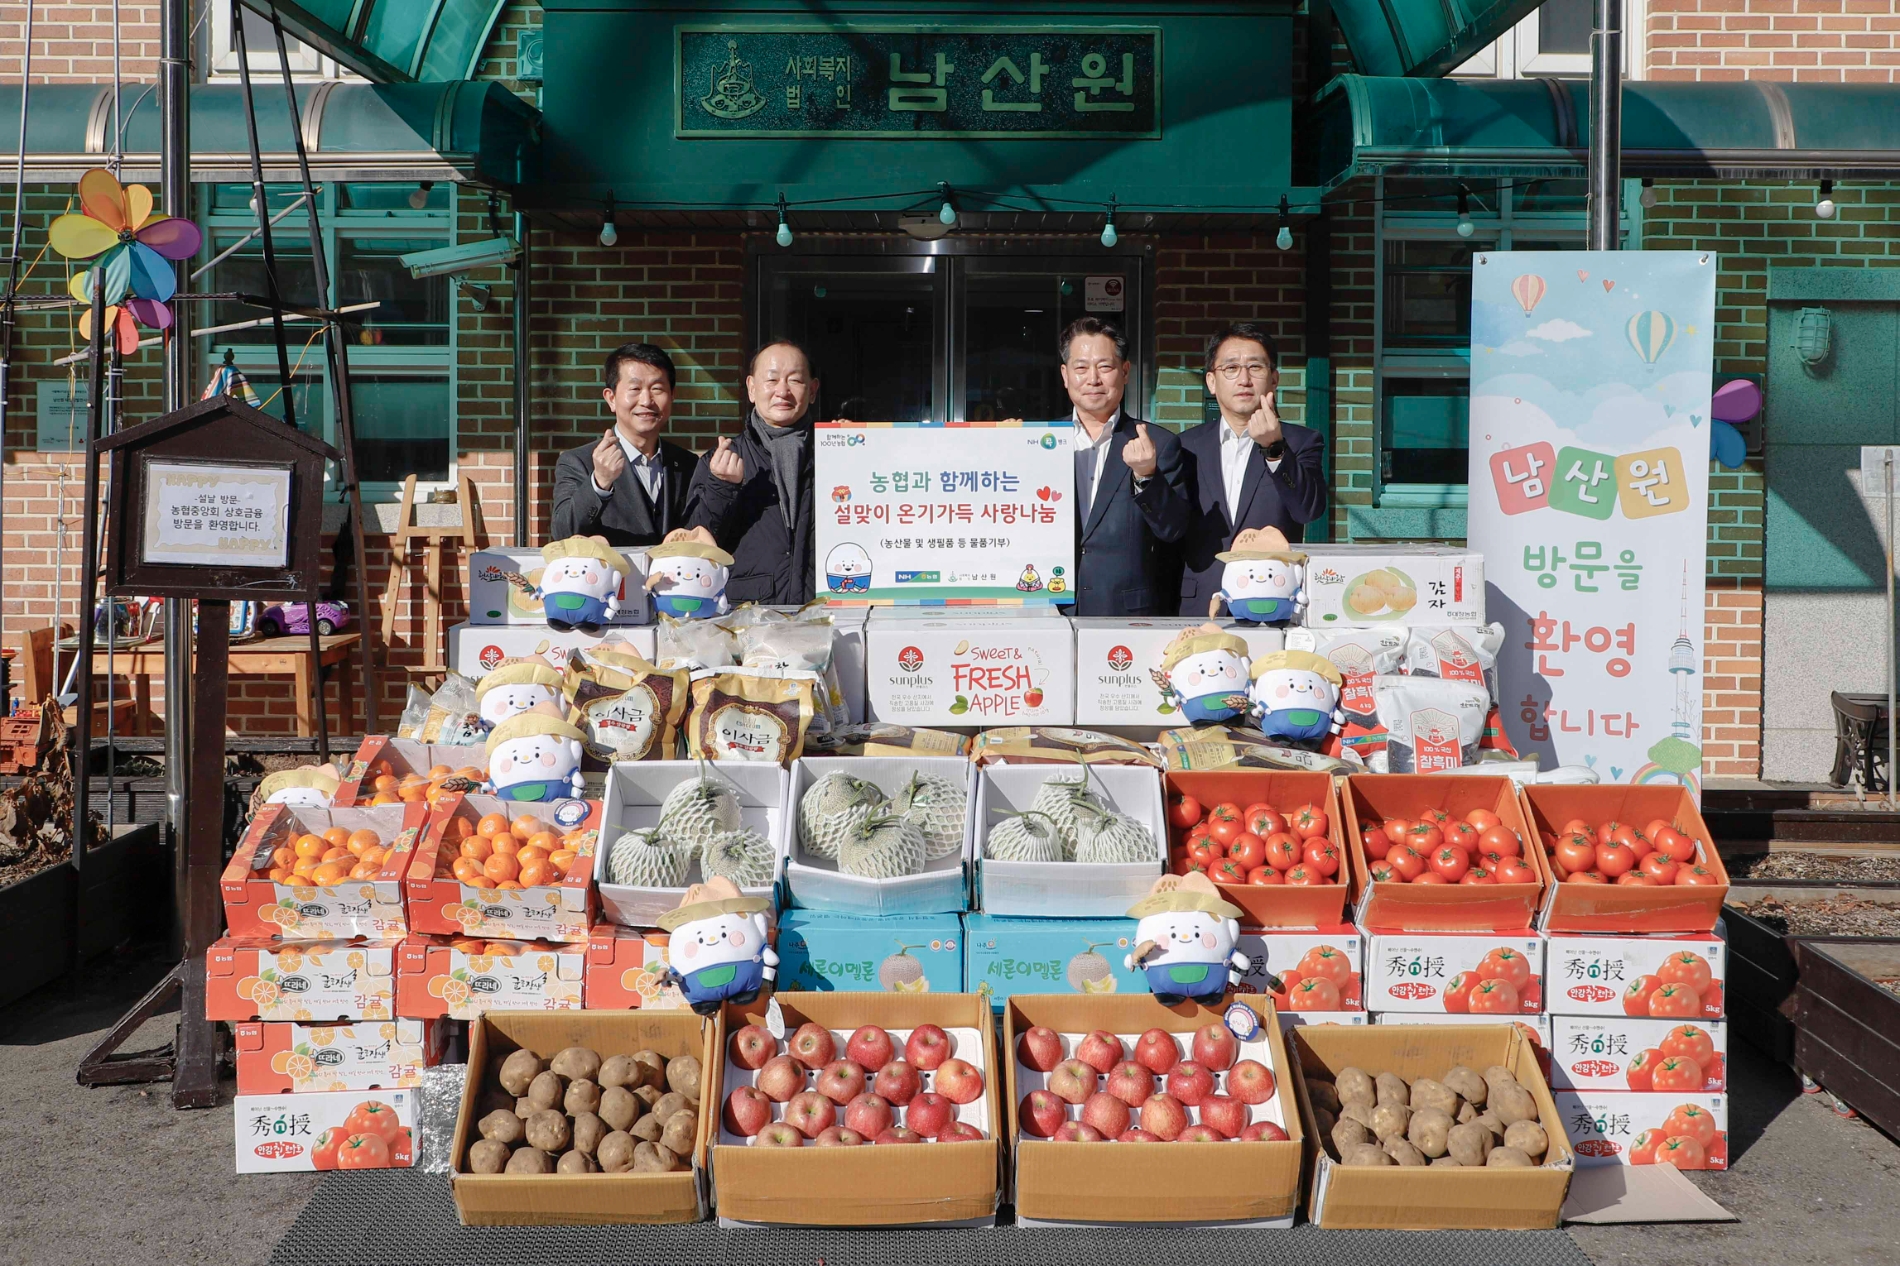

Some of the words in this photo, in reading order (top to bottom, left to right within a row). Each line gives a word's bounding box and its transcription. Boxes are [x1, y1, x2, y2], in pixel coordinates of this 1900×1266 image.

[785, 55, 850, 82] 사회복지
[888, 52, 1135, 112] 남산원
[166, 473, 220, 488] HAPPY
[869, 470, 932, 493] 농협과
[939, 470, 1020, 493] 함께하는
[1502, 452, 1670, 506] 남산원
[171, 505, 220, 517] 농협중앙회
[224, 507, 263, 518] 상호금융
[834, 503, 890, 525] 설맞이
[896, 503, 974, 524] 온기가득
[980, 502, 1057, 524] 사랑나눔
[173, 519, 204, 530] 방문을
[208, 520, 261, 532] 환영합니다.
[218, 536, 272, 551] HAPPY
[880, 537, 912, 549] (농산물
[915, 538, 924, 548] 및
[927, 537, 955, 549] 생필품
[957, 538, 966, 548] 등
[969, 537, 1011, 549] 물품기부)
[1522, 541, 1643, 593] 방문을
[1428, 580, 1447, 609] 감자
[1524, 610, 1635, 678] 환영
[889, 674, 934, 688] sunplus
[950, 663, 1032, 692] FRESH
[1098, 673, 1142, 687] sunplus
[969, 693, 1021, 716] APPLE
[1520, 694, 1640, 741] 합니다
[721, 728, 773, 745] 이사금
[1420, 754, 1458, 770] 찰흑미
[372, 919, 399, 931] 감귤
[555, 923, 582, 935] 감귤
[354, 994, 382, 1010] 감귤
[1345, 998, 1360, 1006] 5kg
[1523, 1000, 1538, 1008] 5kg
[1705, 1004, 1720, 1013] 5kg
[388, 1064, 416, 1079] 감귤
[1707, 1077, 1722, 1085] 5kg
[394, 1152, 410, 1162] 5kg
[1709, 1156, 1724, 1164] 5kg
